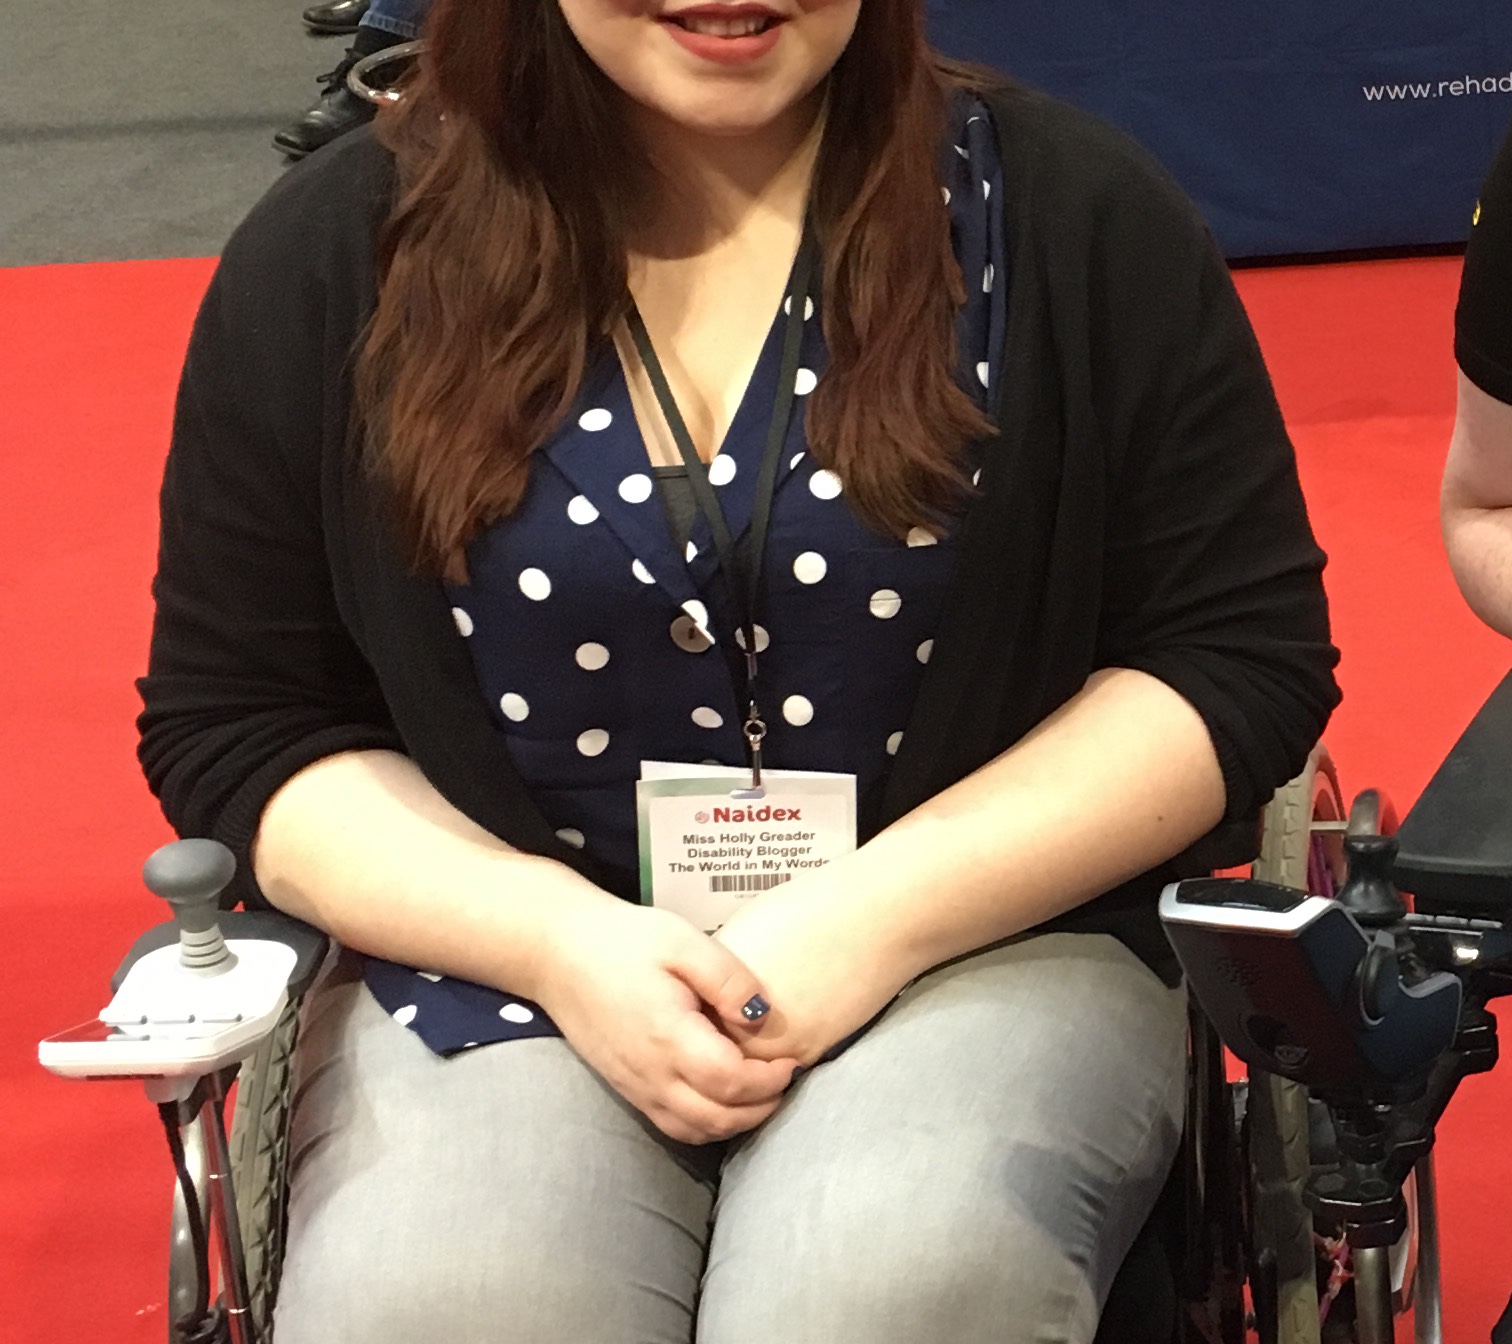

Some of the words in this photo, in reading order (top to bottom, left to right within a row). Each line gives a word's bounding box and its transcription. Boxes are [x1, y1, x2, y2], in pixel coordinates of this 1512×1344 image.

[713, 805, 802, 823] Naidex
[683, 833, 715, 845] Miss
[719, 832, 756, 846] Holly
[760, 830, 815, 842] Greader
[687, 846, 753, 859] Disability
[757, 844, 812, 857] Blogger
[669, 862, 695, 873] The
[699, 861, 739, 872] World
[744, 861, 758, 870] in
[762, 859, 782, 871] My
